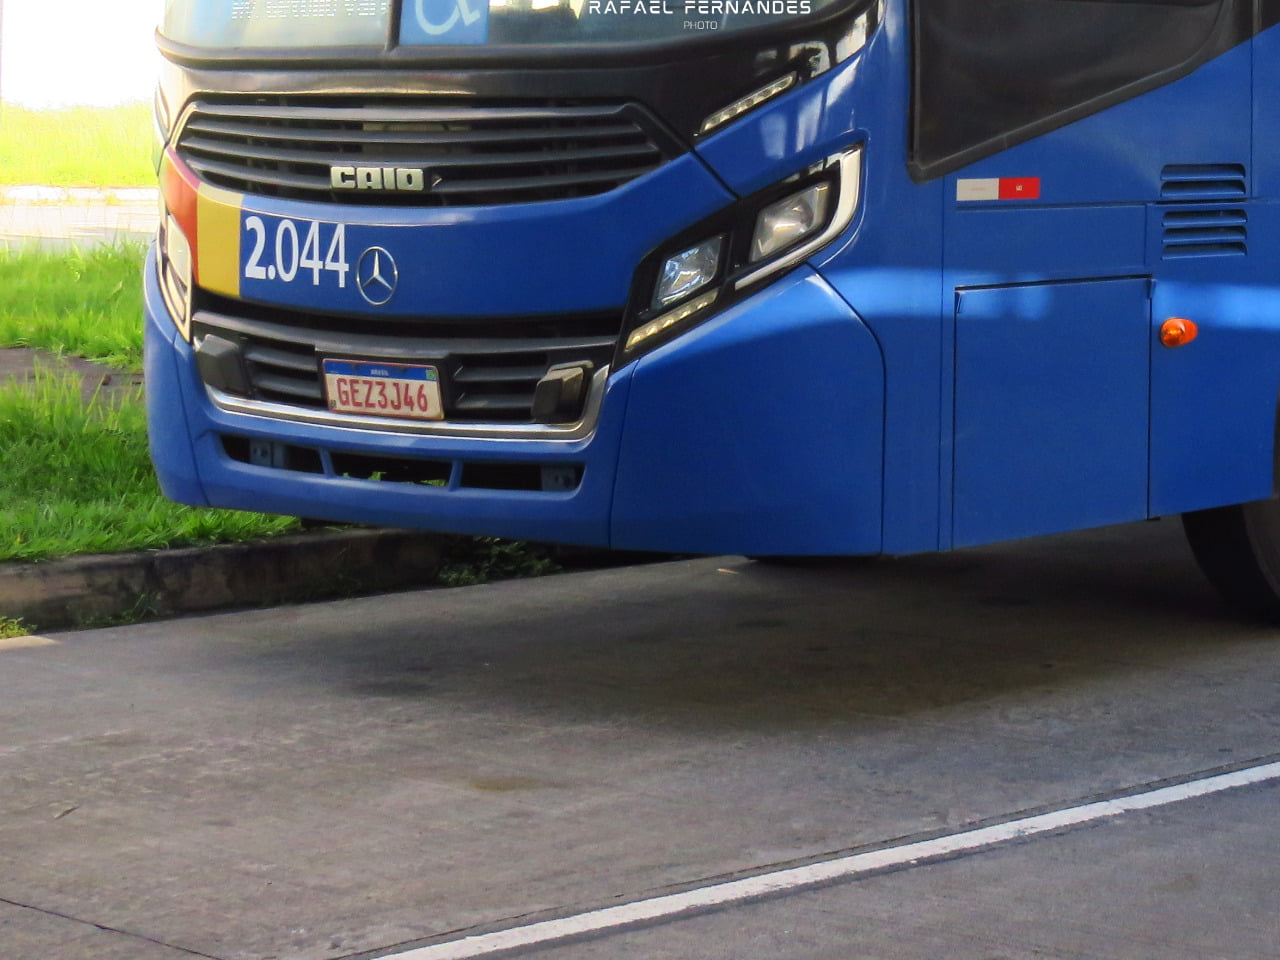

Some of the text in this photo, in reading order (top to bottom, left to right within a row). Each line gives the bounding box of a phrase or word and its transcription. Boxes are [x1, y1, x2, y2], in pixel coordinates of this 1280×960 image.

[330, 166, 424, 191] CAIO
[245, 216, 349, 288] 2.044
[336, 377, 428, 413] GEZ3J46
